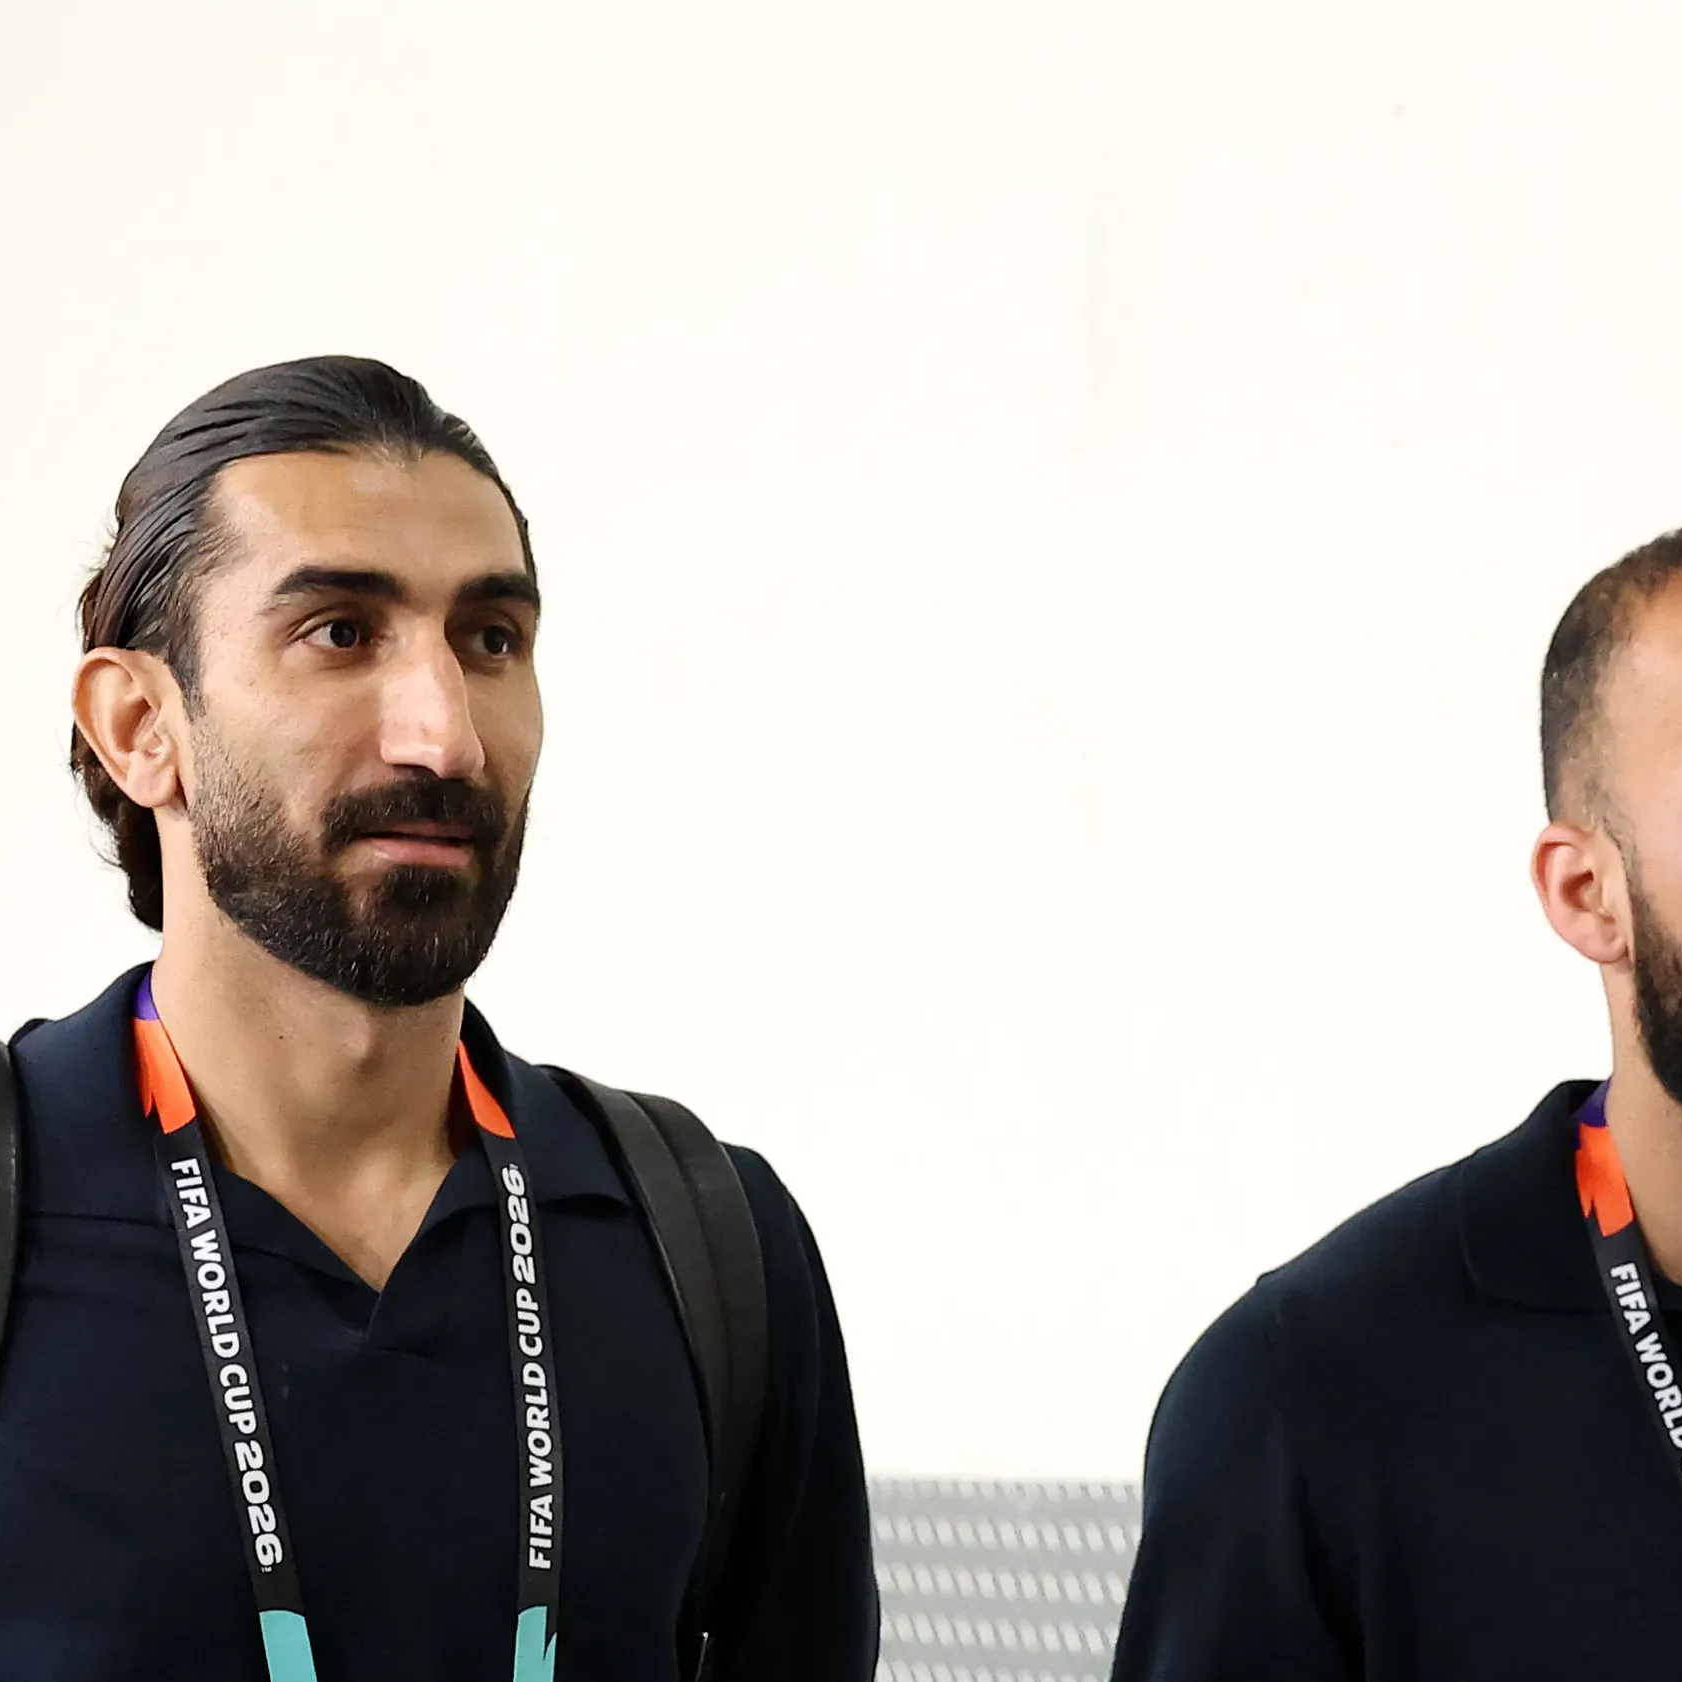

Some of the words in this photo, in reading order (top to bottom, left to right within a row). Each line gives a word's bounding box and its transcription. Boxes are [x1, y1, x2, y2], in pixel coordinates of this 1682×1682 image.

[170, 1158, 212, 1229] FIFA
[501, 1163, 536, 1285] 2026
[190, 1229, 240, 1358] WORLD
[515, 1287, 543, 1357] CUP
[1609, 1262, 1651, 1335] FIFA
[219, 1363, 257, 1434] CUP
[522, 1362, 553, 1488] WORLD
[234, 1439, 283, 1567] 2026
[528, 1494, 553, 1569] FIFA
